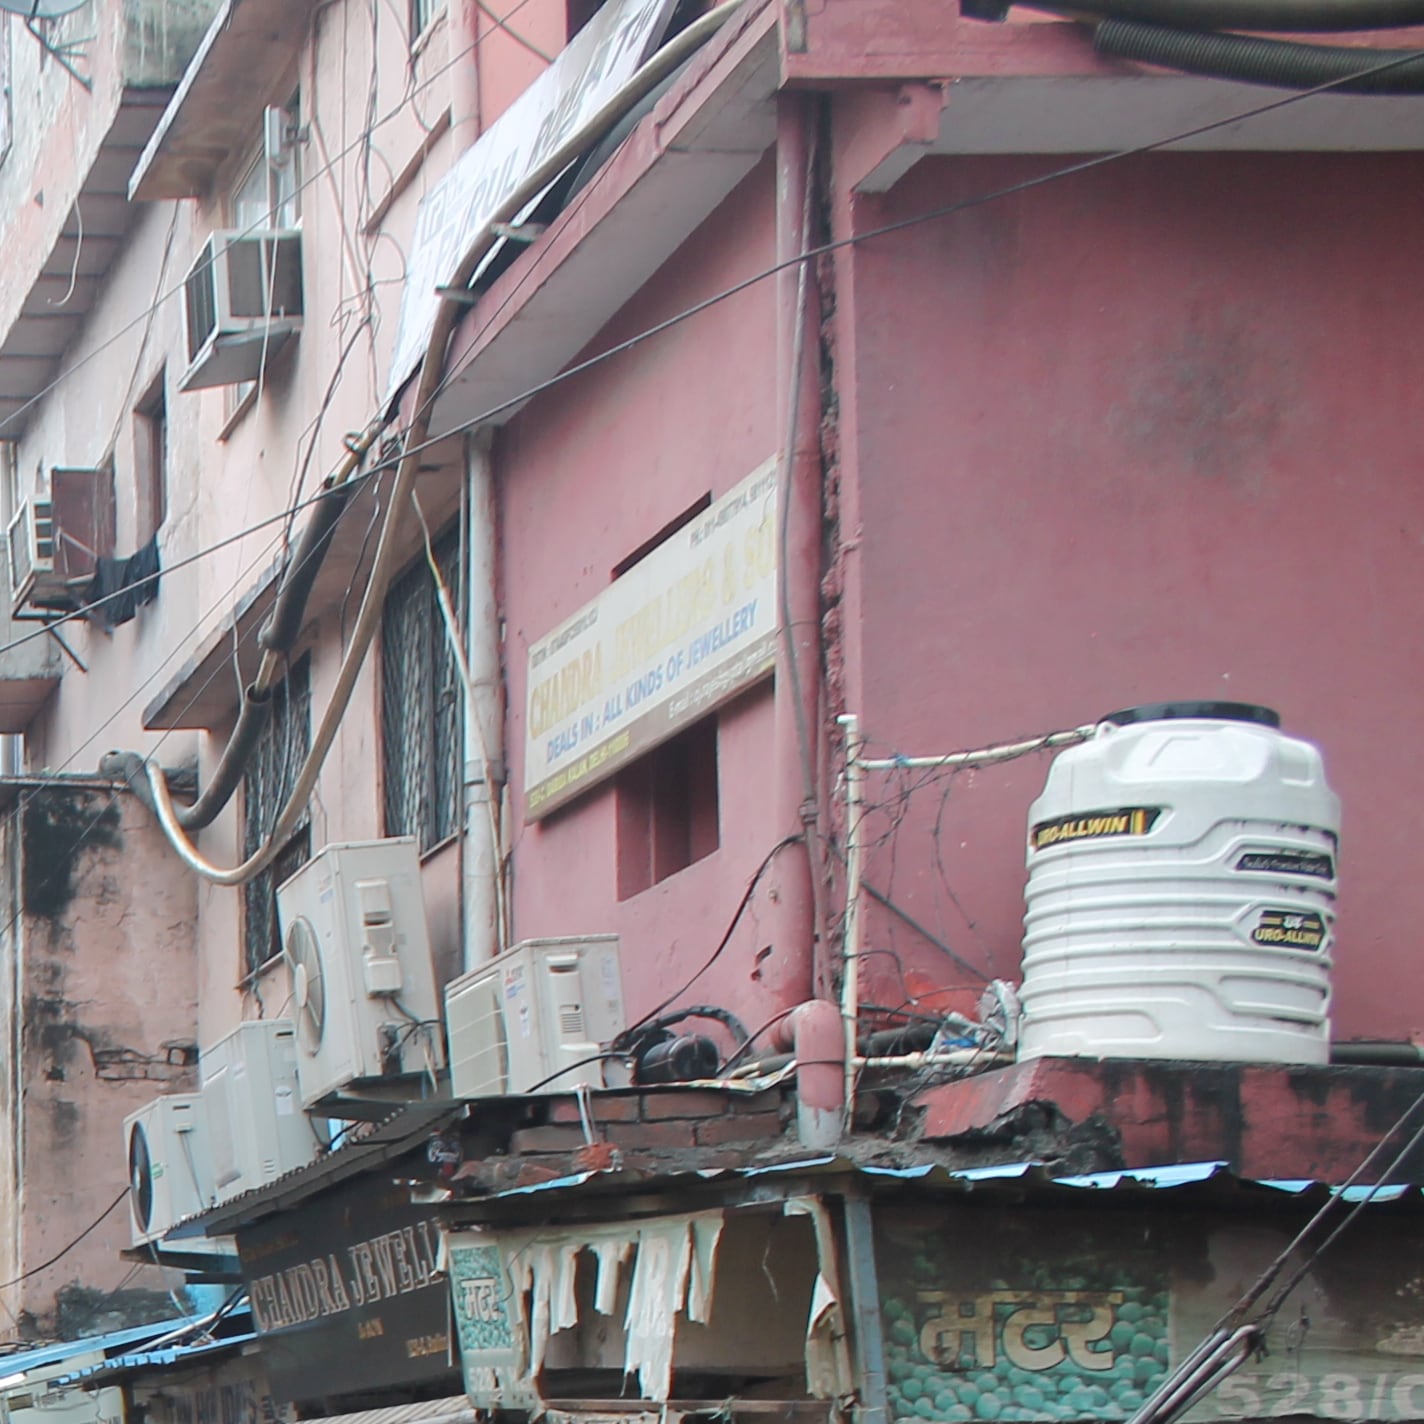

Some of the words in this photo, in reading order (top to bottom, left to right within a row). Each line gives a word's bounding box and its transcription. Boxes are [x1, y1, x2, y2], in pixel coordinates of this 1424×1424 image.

[547, 722, 578, 764] DEALS
[581, 712, 594, 742] IN
[602, 693, 623, 726] ALL
[626, 665, 663, 711] KINDS
[666, 650, 683, 683] OF
[686, 599, 757, 671] JEWELLERY
[252, 1254, 351, 1333] CHANDRA
[348, 1217, 450, 1308] JEWELL
[917, 1290, 1124, 1372] मटर
